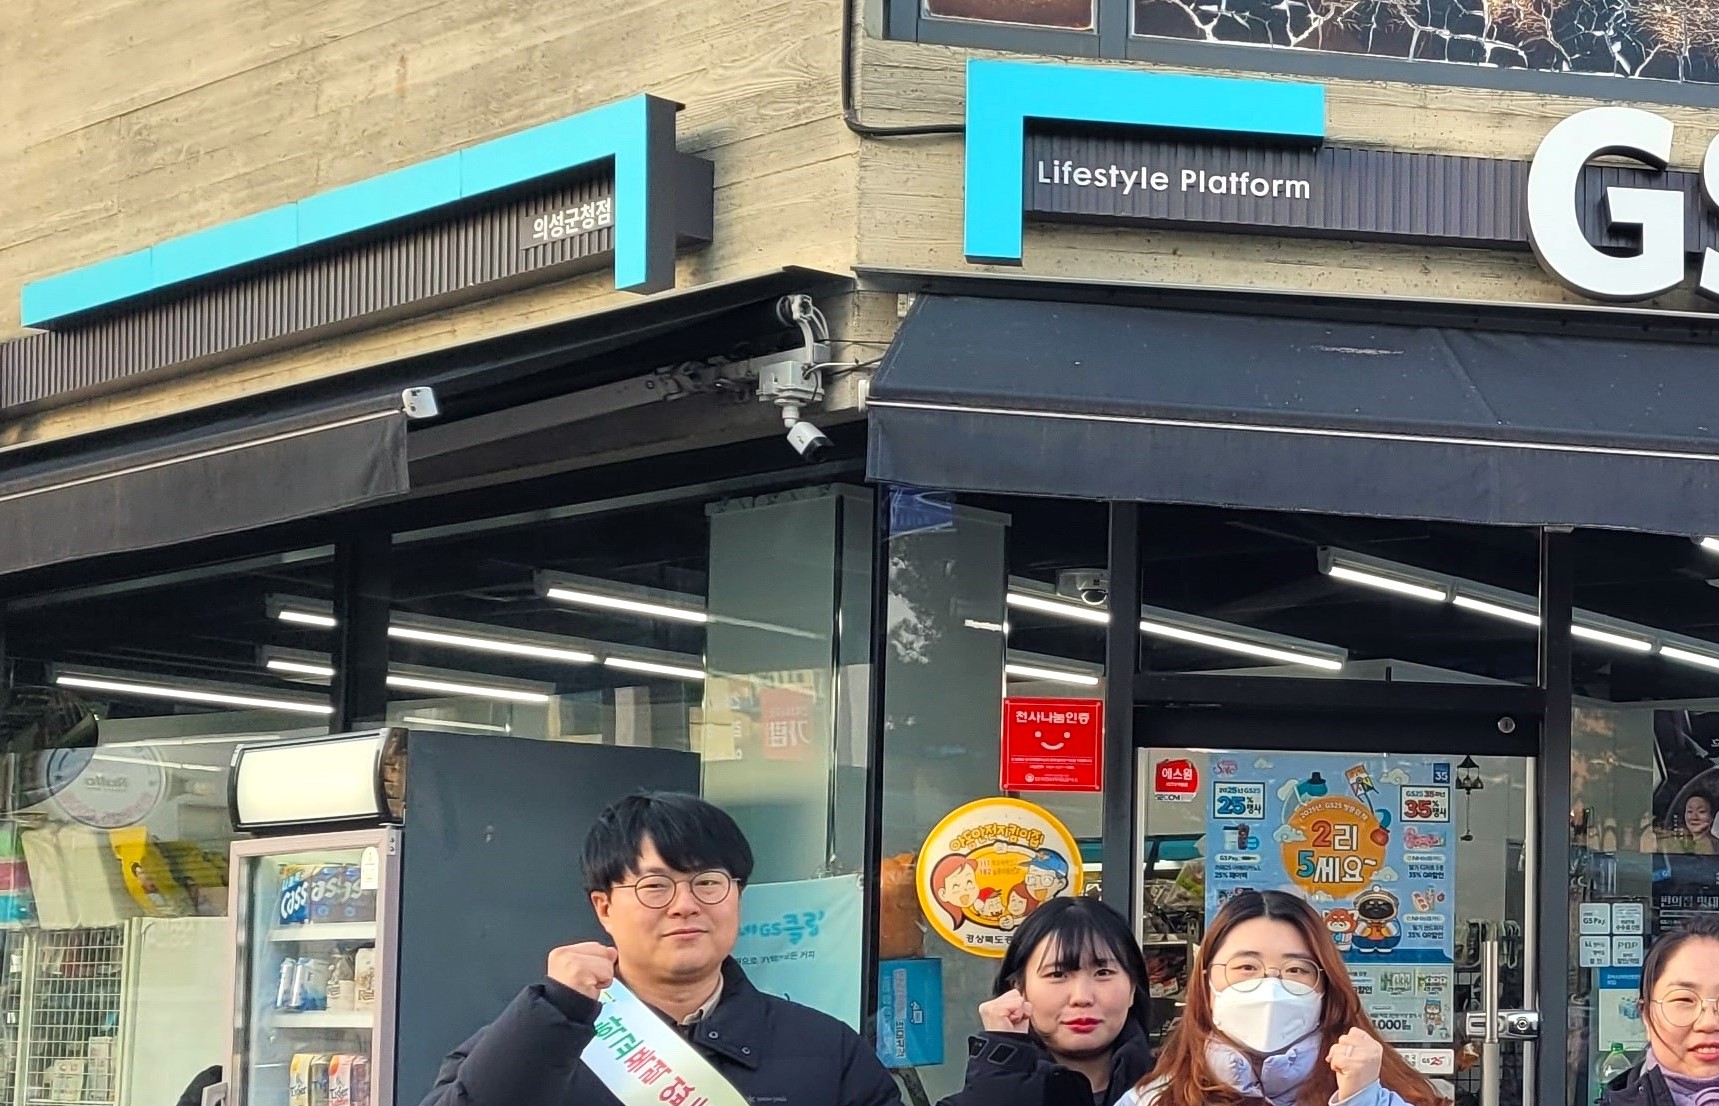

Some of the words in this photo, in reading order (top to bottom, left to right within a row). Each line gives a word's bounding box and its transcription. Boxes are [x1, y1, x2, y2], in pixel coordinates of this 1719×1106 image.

[1038, 160, 1169, 195] Lifestyle
[1181, 169, 1311, 199] Platform
[532, 197, 612, 240] 의성군청점
[1015, 710, 1090, 725] 천사나눔인증
[1161, 767, 1193, 781] 에스원
[1311, 819, 1358, 851] 2리
[280, 881, 308, 919] Cass
